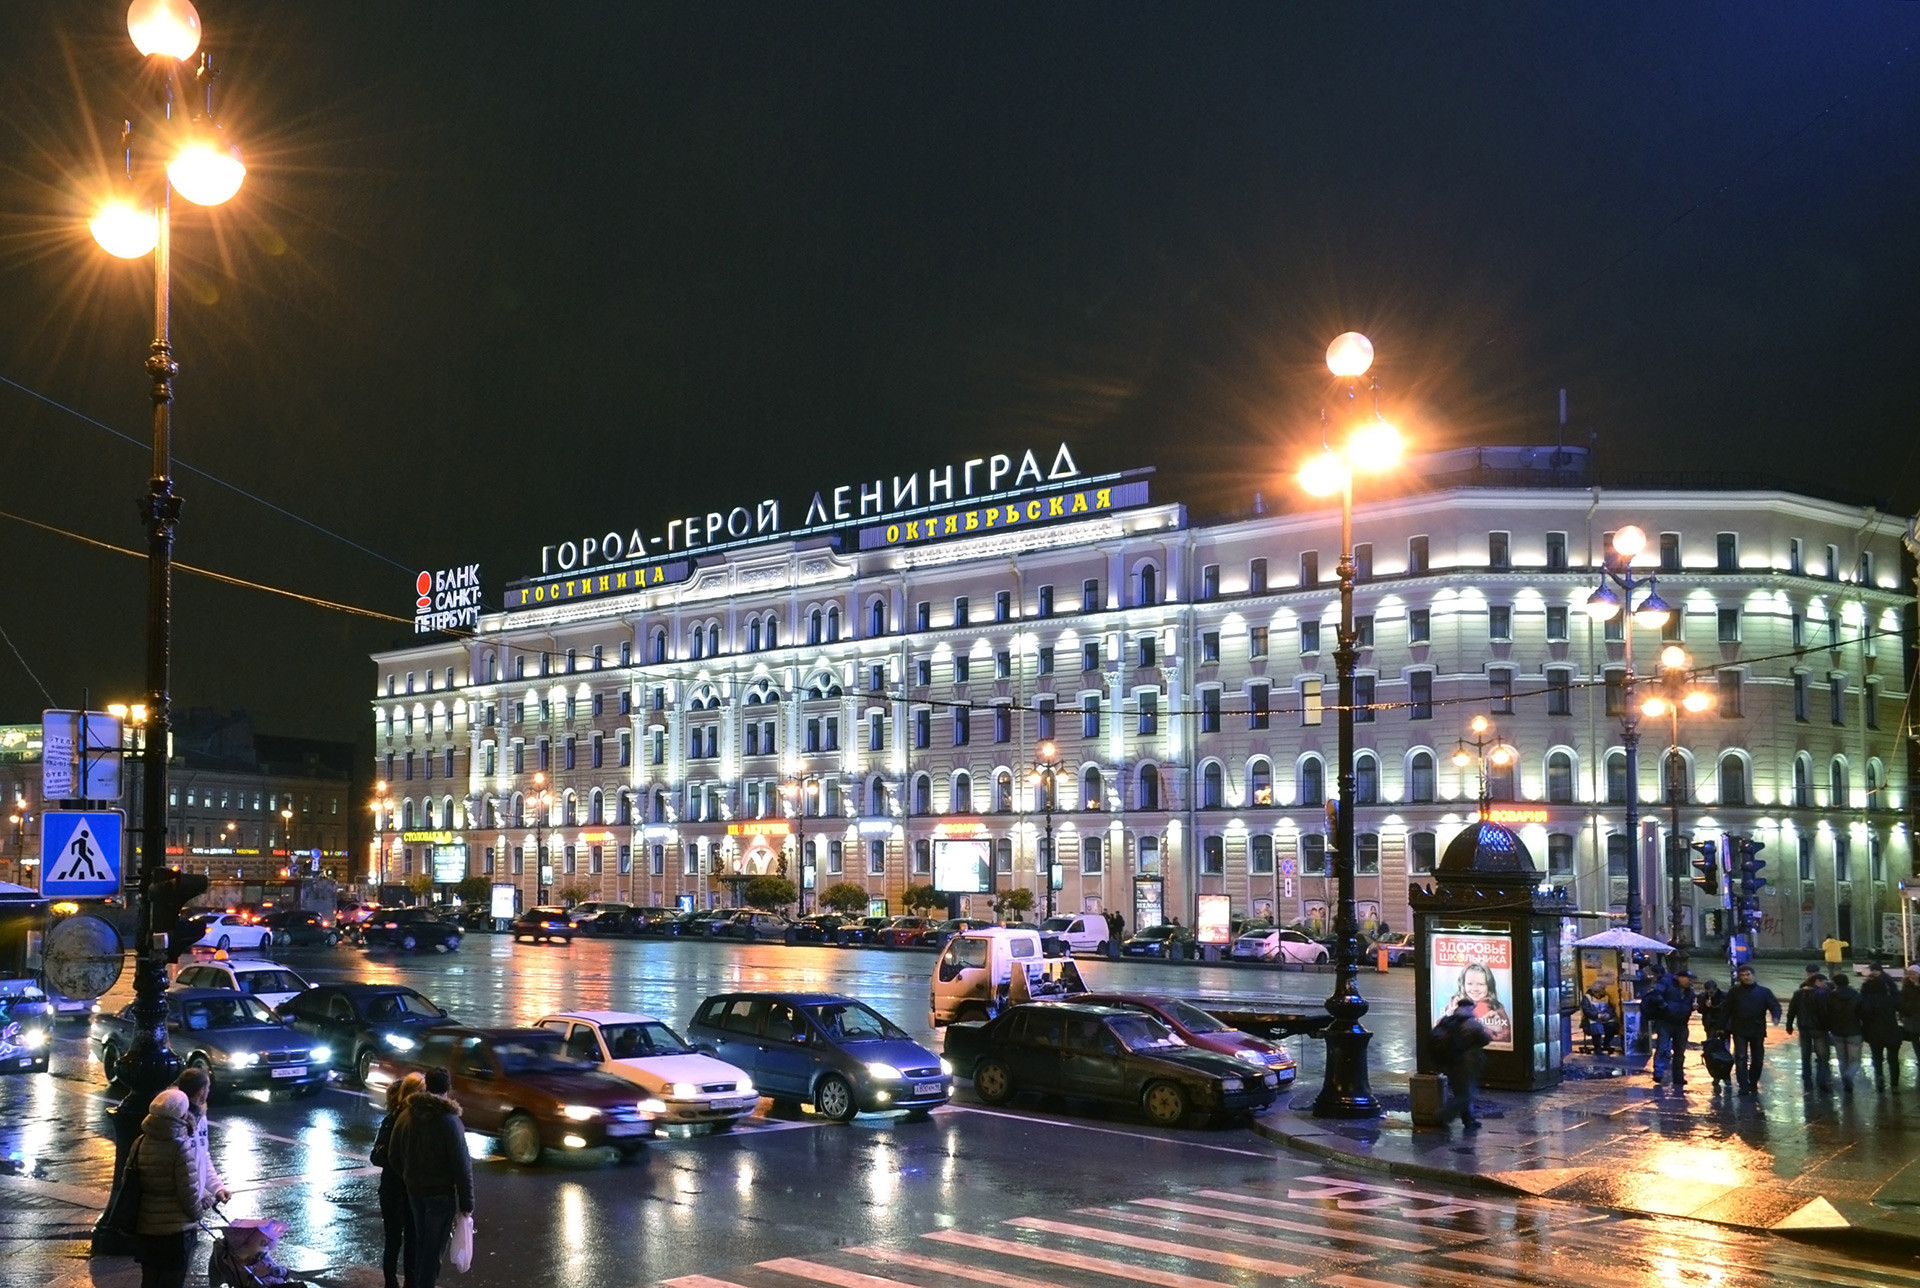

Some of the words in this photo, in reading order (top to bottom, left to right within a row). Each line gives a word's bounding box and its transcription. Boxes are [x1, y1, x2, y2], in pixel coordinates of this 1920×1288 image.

[542, 499, 780, 574] ГОРОД-ГЕРОЙ
[805, 442, 1080, 526] ЛЕНИНГРАД
[521, 566, 665, 604] ГОСТИНИЦА
[886, 488, 1112, 543] ОКТЯБРЬСКАЯ
[435, 563, 480, 592] БАНК
[414, 605, 481, 634] ПЕТЕРБУРГ
[1477, 810, 1548, 823] ВОВАРНЯ
[1439, 942, 1507, 955] ЗДОРОВЬЕ
[1439, 952, 1507, 964] ШКОЛЬНИКА
